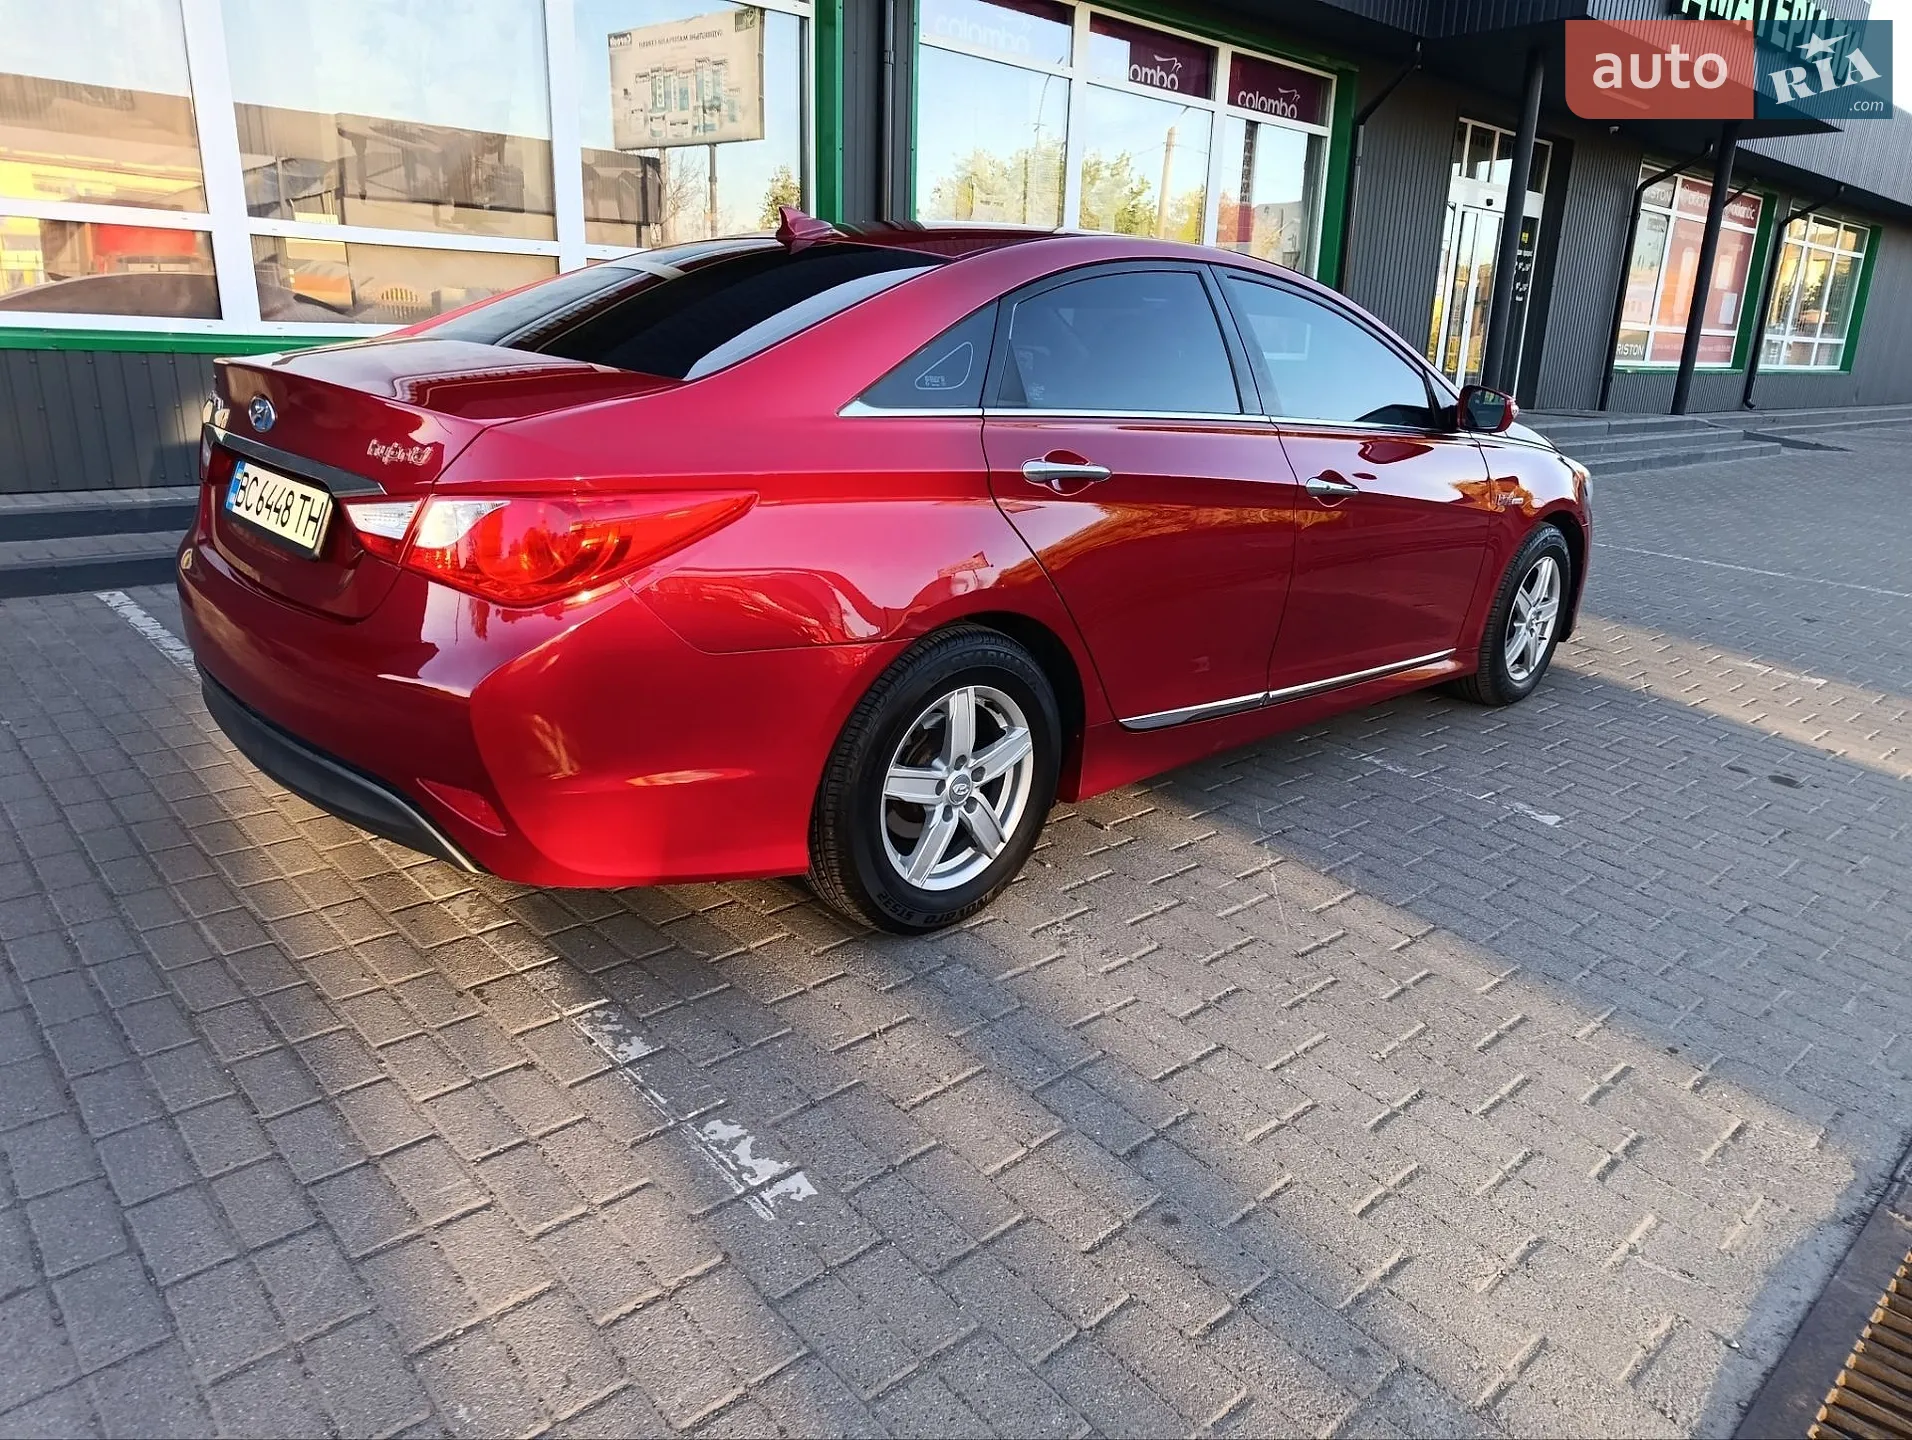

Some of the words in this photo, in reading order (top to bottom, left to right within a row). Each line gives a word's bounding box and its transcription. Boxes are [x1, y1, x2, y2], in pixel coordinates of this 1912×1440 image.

[1129, 63, 1179, 91] ombo
[1237, 88, 1299, 119] colombo
[1616, 342, 1645, 356] RISTON
